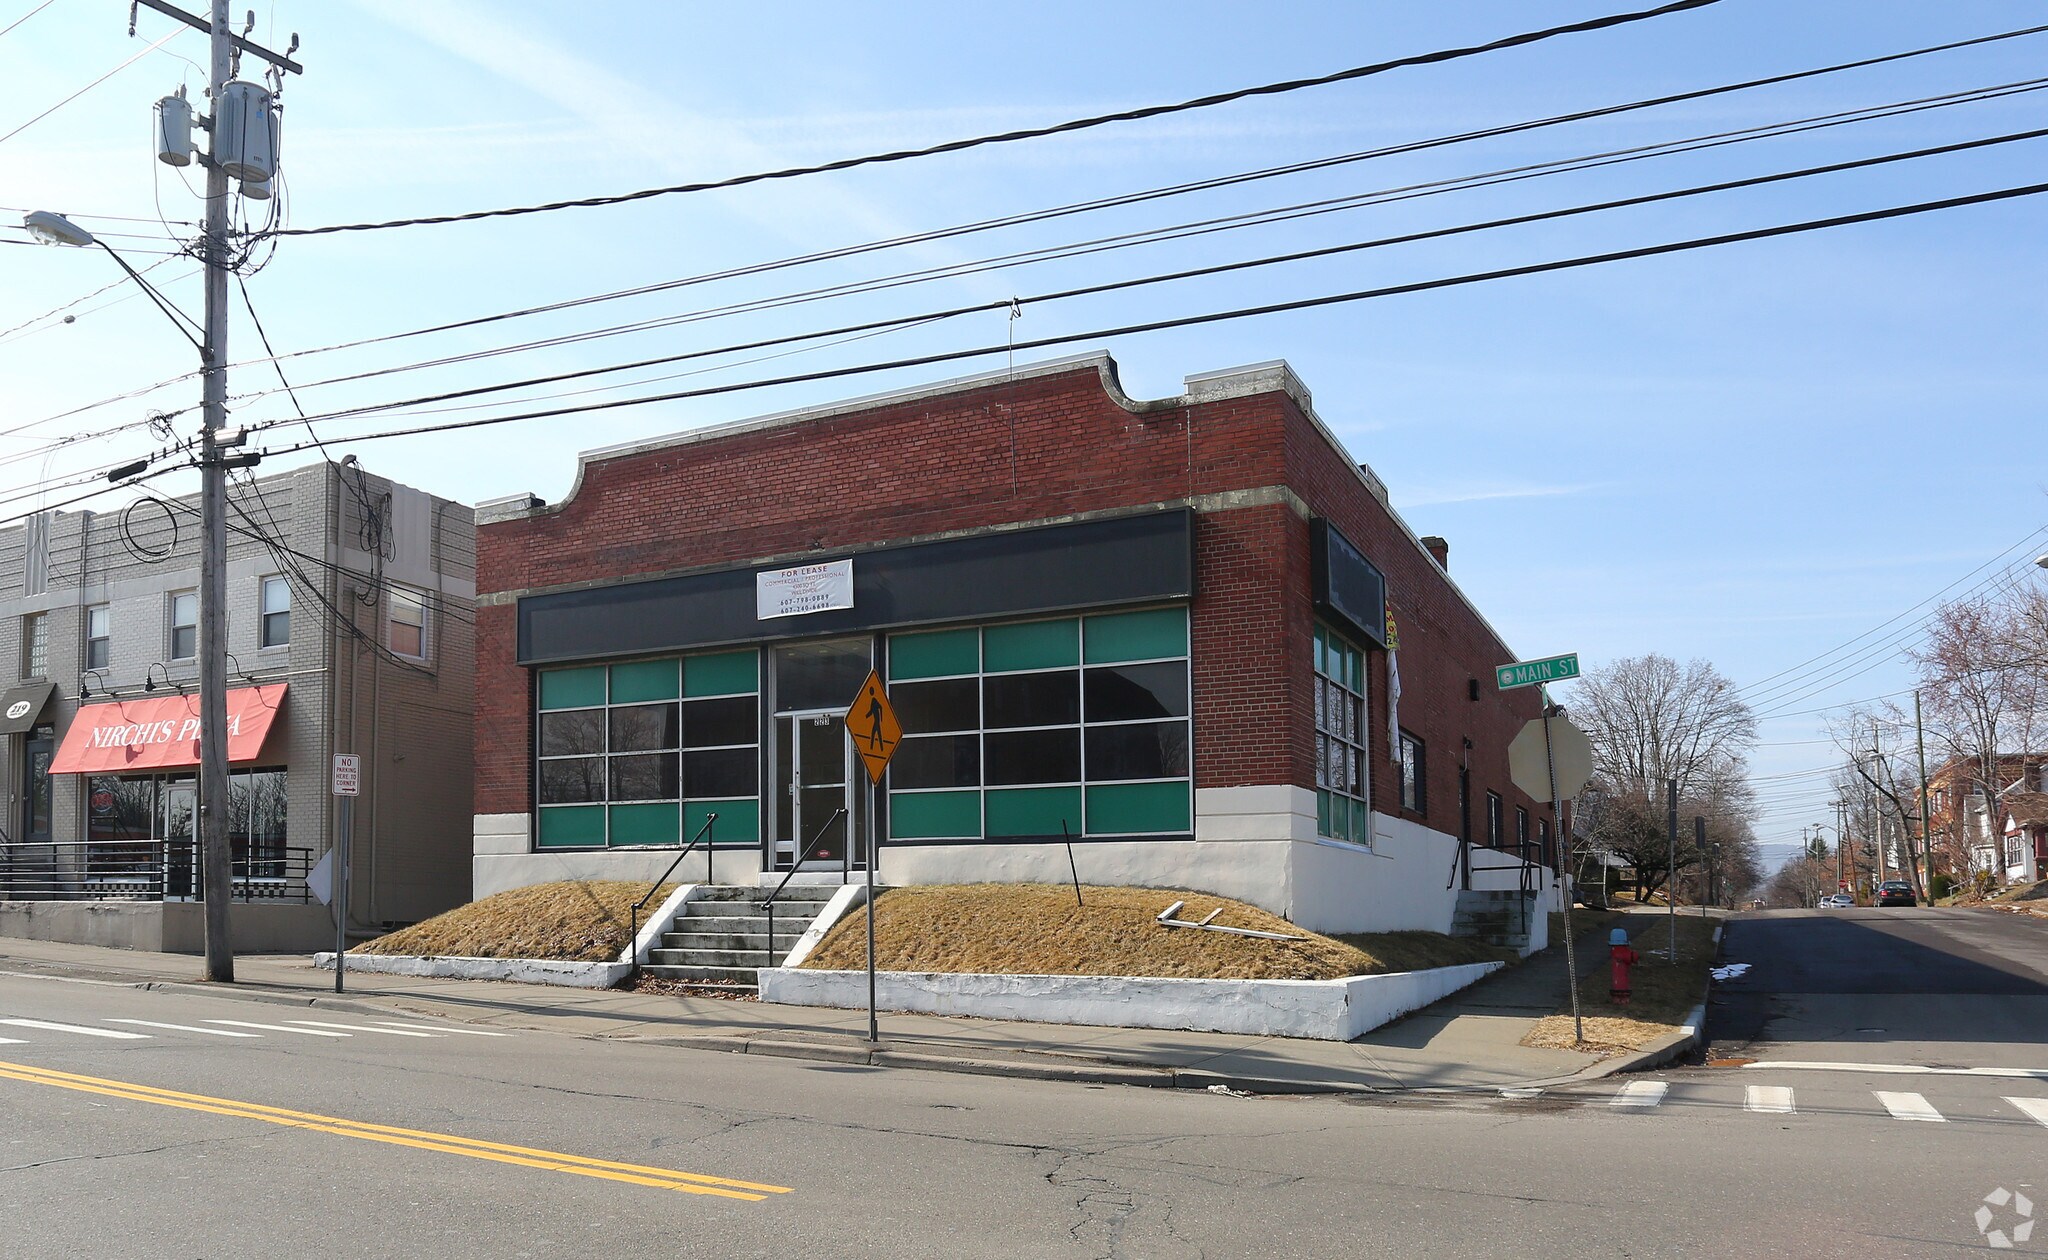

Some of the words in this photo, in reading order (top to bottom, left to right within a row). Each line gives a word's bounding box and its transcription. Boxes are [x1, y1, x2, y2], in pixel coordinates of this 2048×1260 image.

[781, 569, 798, 578] FOR
[801, 565, 828, 575] LEASE
[764, 578, 800, 587] COMMERCIAL
[805, 571, 845, 581] PROFESSIONAL
[780, 594, 829, 606] 607-798-0889
[780, 602, 830, 614] 607-240-6698
[1515, 662, 1552, 683] MAIN
[1558, 658, 1576, 675] ST
[11, 704, 28, 713] 219
[85, 719, 175, 748] NIRCHI'S
[176, 714, 241, 742] PIA
[341, 758, 352, 766] NO
